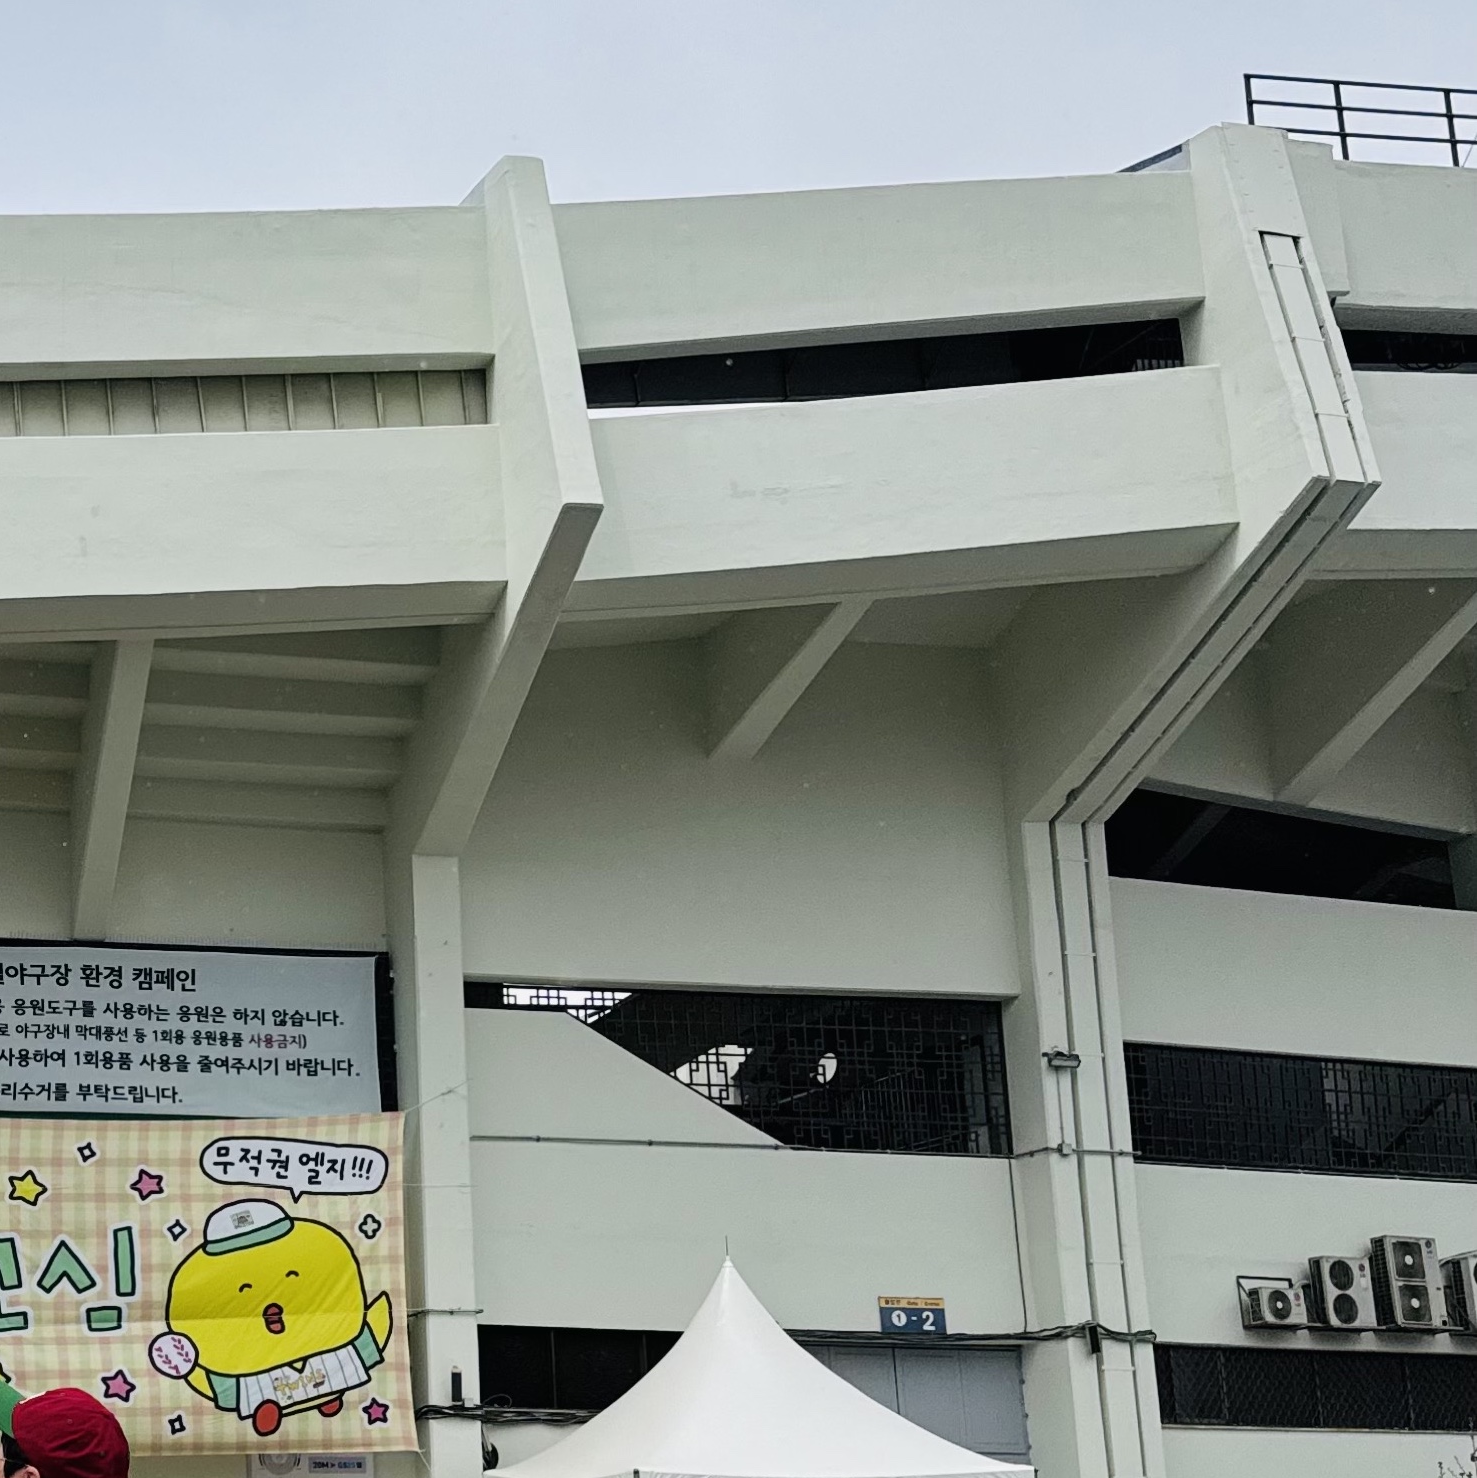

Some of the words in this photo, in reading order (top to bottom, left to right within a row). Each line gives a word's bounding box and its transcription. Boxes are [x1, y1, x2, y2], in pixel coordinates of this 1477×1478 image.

[80, 964, 123, 989] 환경
[132, 967, 197, 992] 캠페인
[11, 998, 97, 1018] 응원도구를
[103, 1002, 171, 1022] 사용하는
[177, 1005, 226, 1024] 응원은
[232, 1008, 265, 1026] 하지
[272, 1009, 344, 1027] 않습니다.
[16, 1023, 70, 1040] 야구장내
[75, 1025, 128, 1043] 막대풍선
[133, 1028, 147, 1043] 등
[152, 1029, 186, 1045] 1회용
[191, 1030, 243, 1048] 응원용품
[249, 1033, 307, 1049] 사용금지)
[74, 1051, 133, 1070] 1회용품
[139, 1054, 190, 1073] 사용을
[197, 1055, 279, 1076] 줄여주시기
[286, 1058, 360, 1077] 바랍니다.
[76, 1083, 183, 1104] 부탁드립니다.
[213, 1146, 290, 1180] 무적권
[299, 1151, 374, 1185] 엘지!!!
